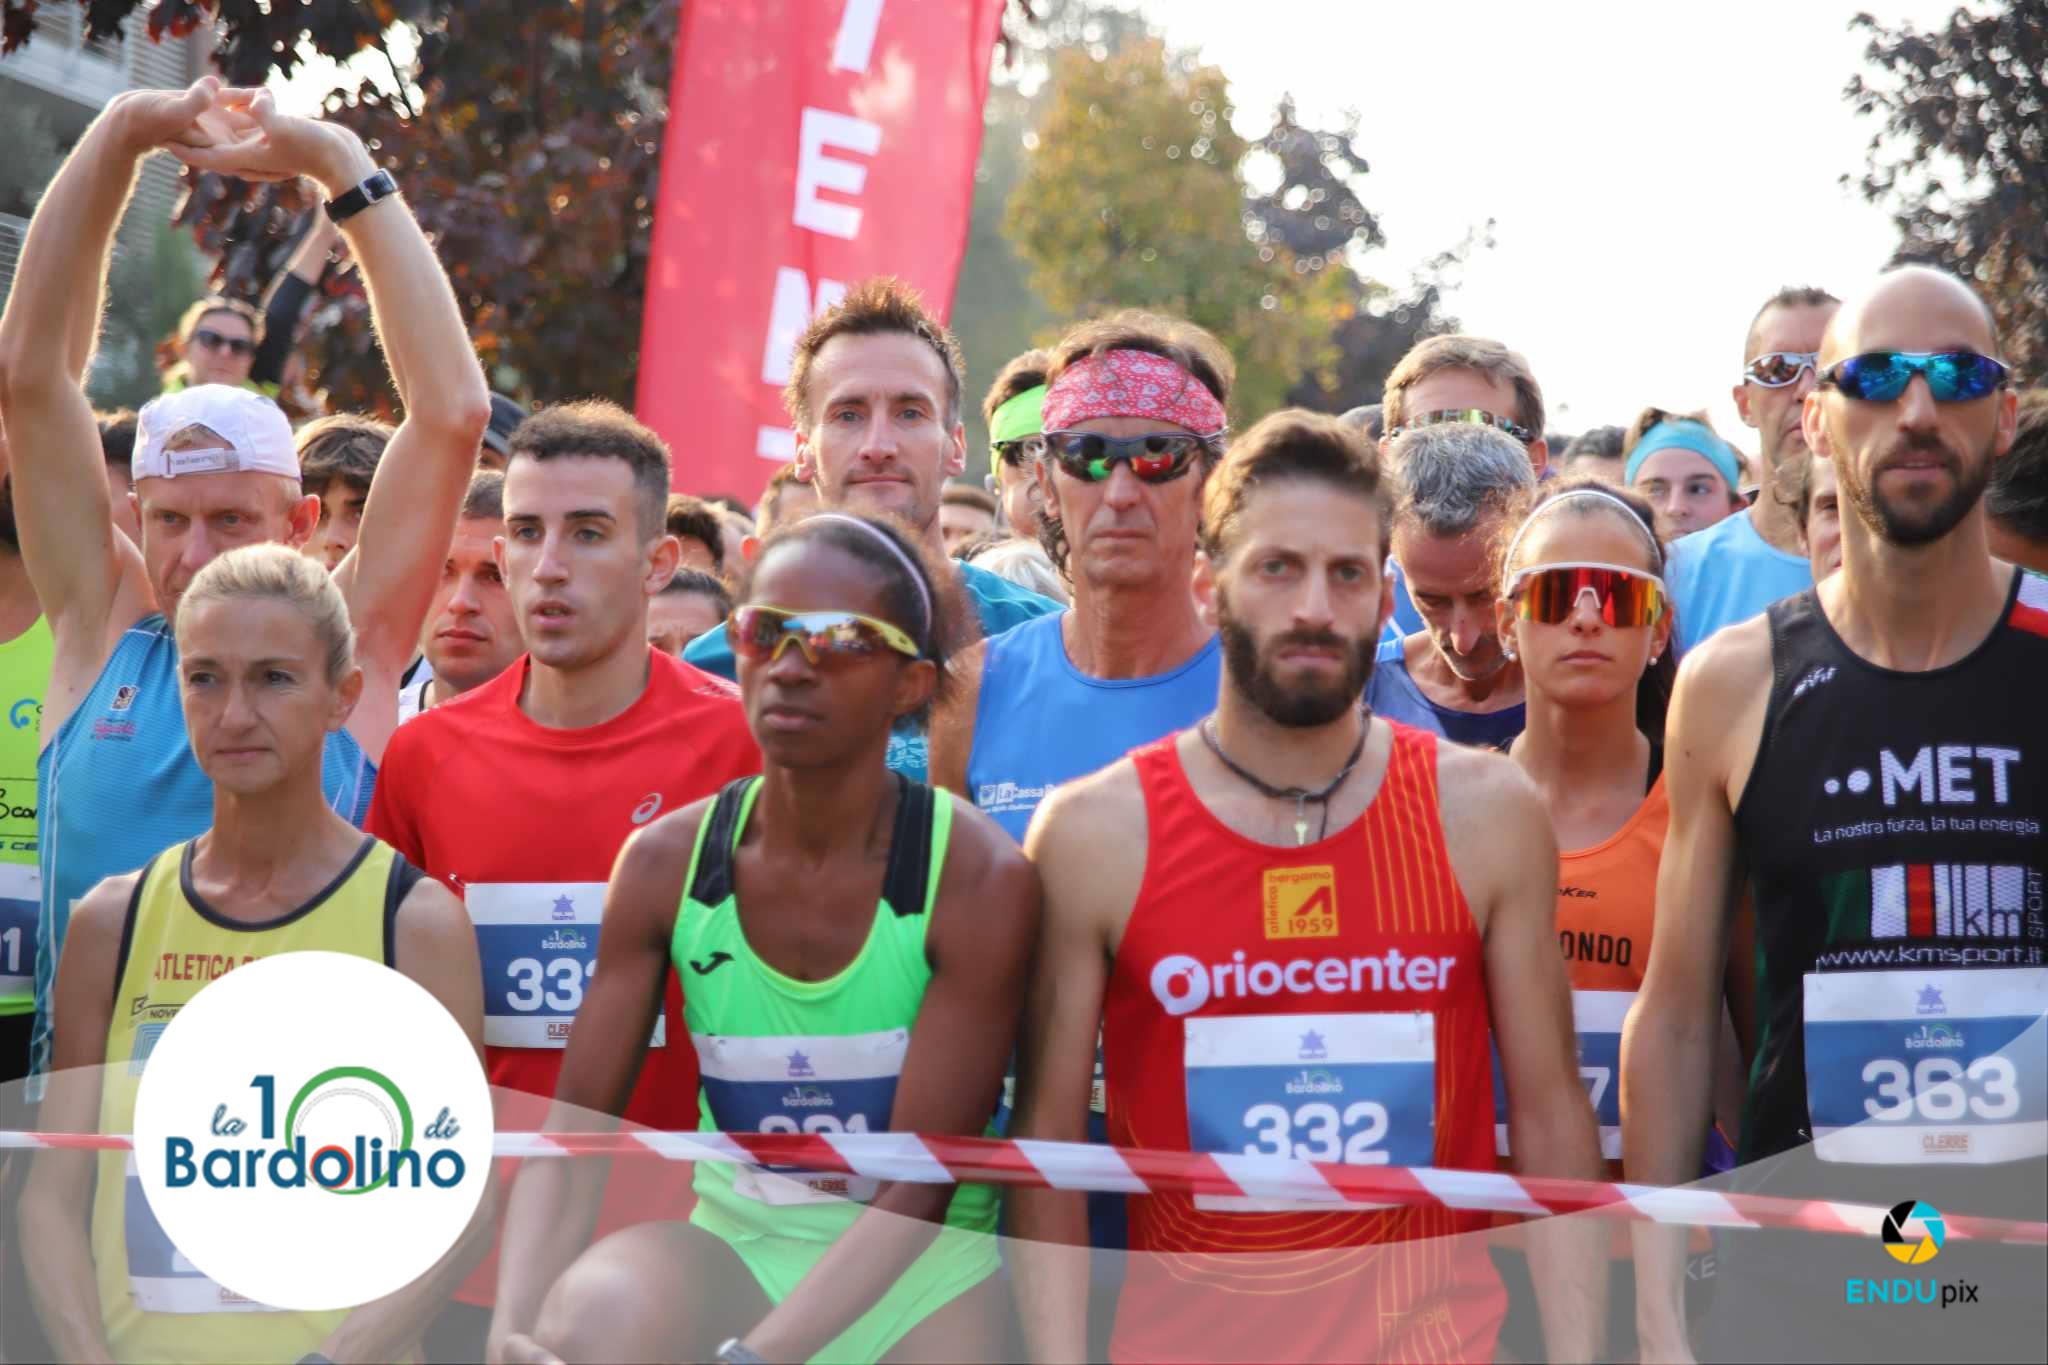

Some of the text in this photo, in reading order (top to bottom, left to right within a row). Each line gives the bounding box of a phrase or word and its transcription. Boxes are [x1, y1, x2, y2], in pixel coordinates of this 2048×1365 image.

[1880, 746, 2021, 805] MET
[1814, 816, 2040, 843] La nostra forza, la tua energia
[1288, 917, 1333, 934] 1959
[506, 957, 597, 1012] 33
[1150, 949, 1455, 1015] Oriocenter
[1904, 1036, 1965, 1049] Bardolino
[1862, 1057, 2020, 1121] 363
[1243, 1101, 1390, 1165] 332
